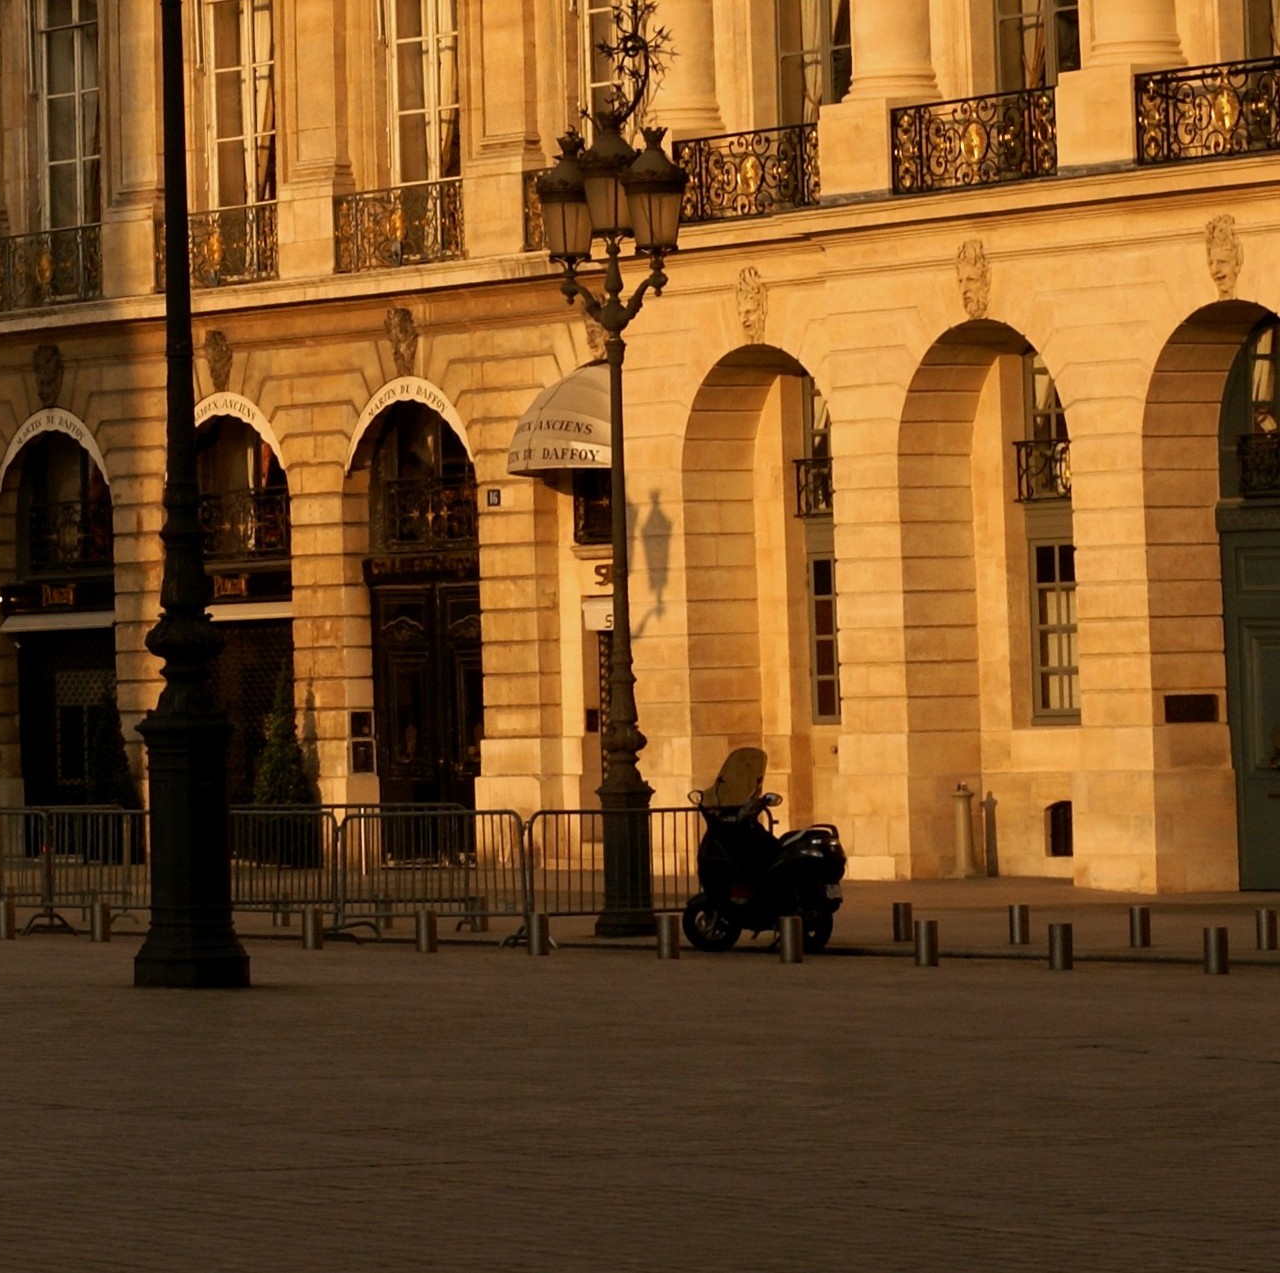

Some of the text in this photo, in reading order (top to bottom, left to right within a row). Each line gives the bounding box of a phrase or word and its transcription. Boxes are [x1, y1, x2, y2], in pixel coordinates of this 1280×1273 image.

[416, 384, 447, 414] DAFFOY
[534, 419, 593, 435] ANCIENS
[542, 447, 600, 462] DAFFOY
